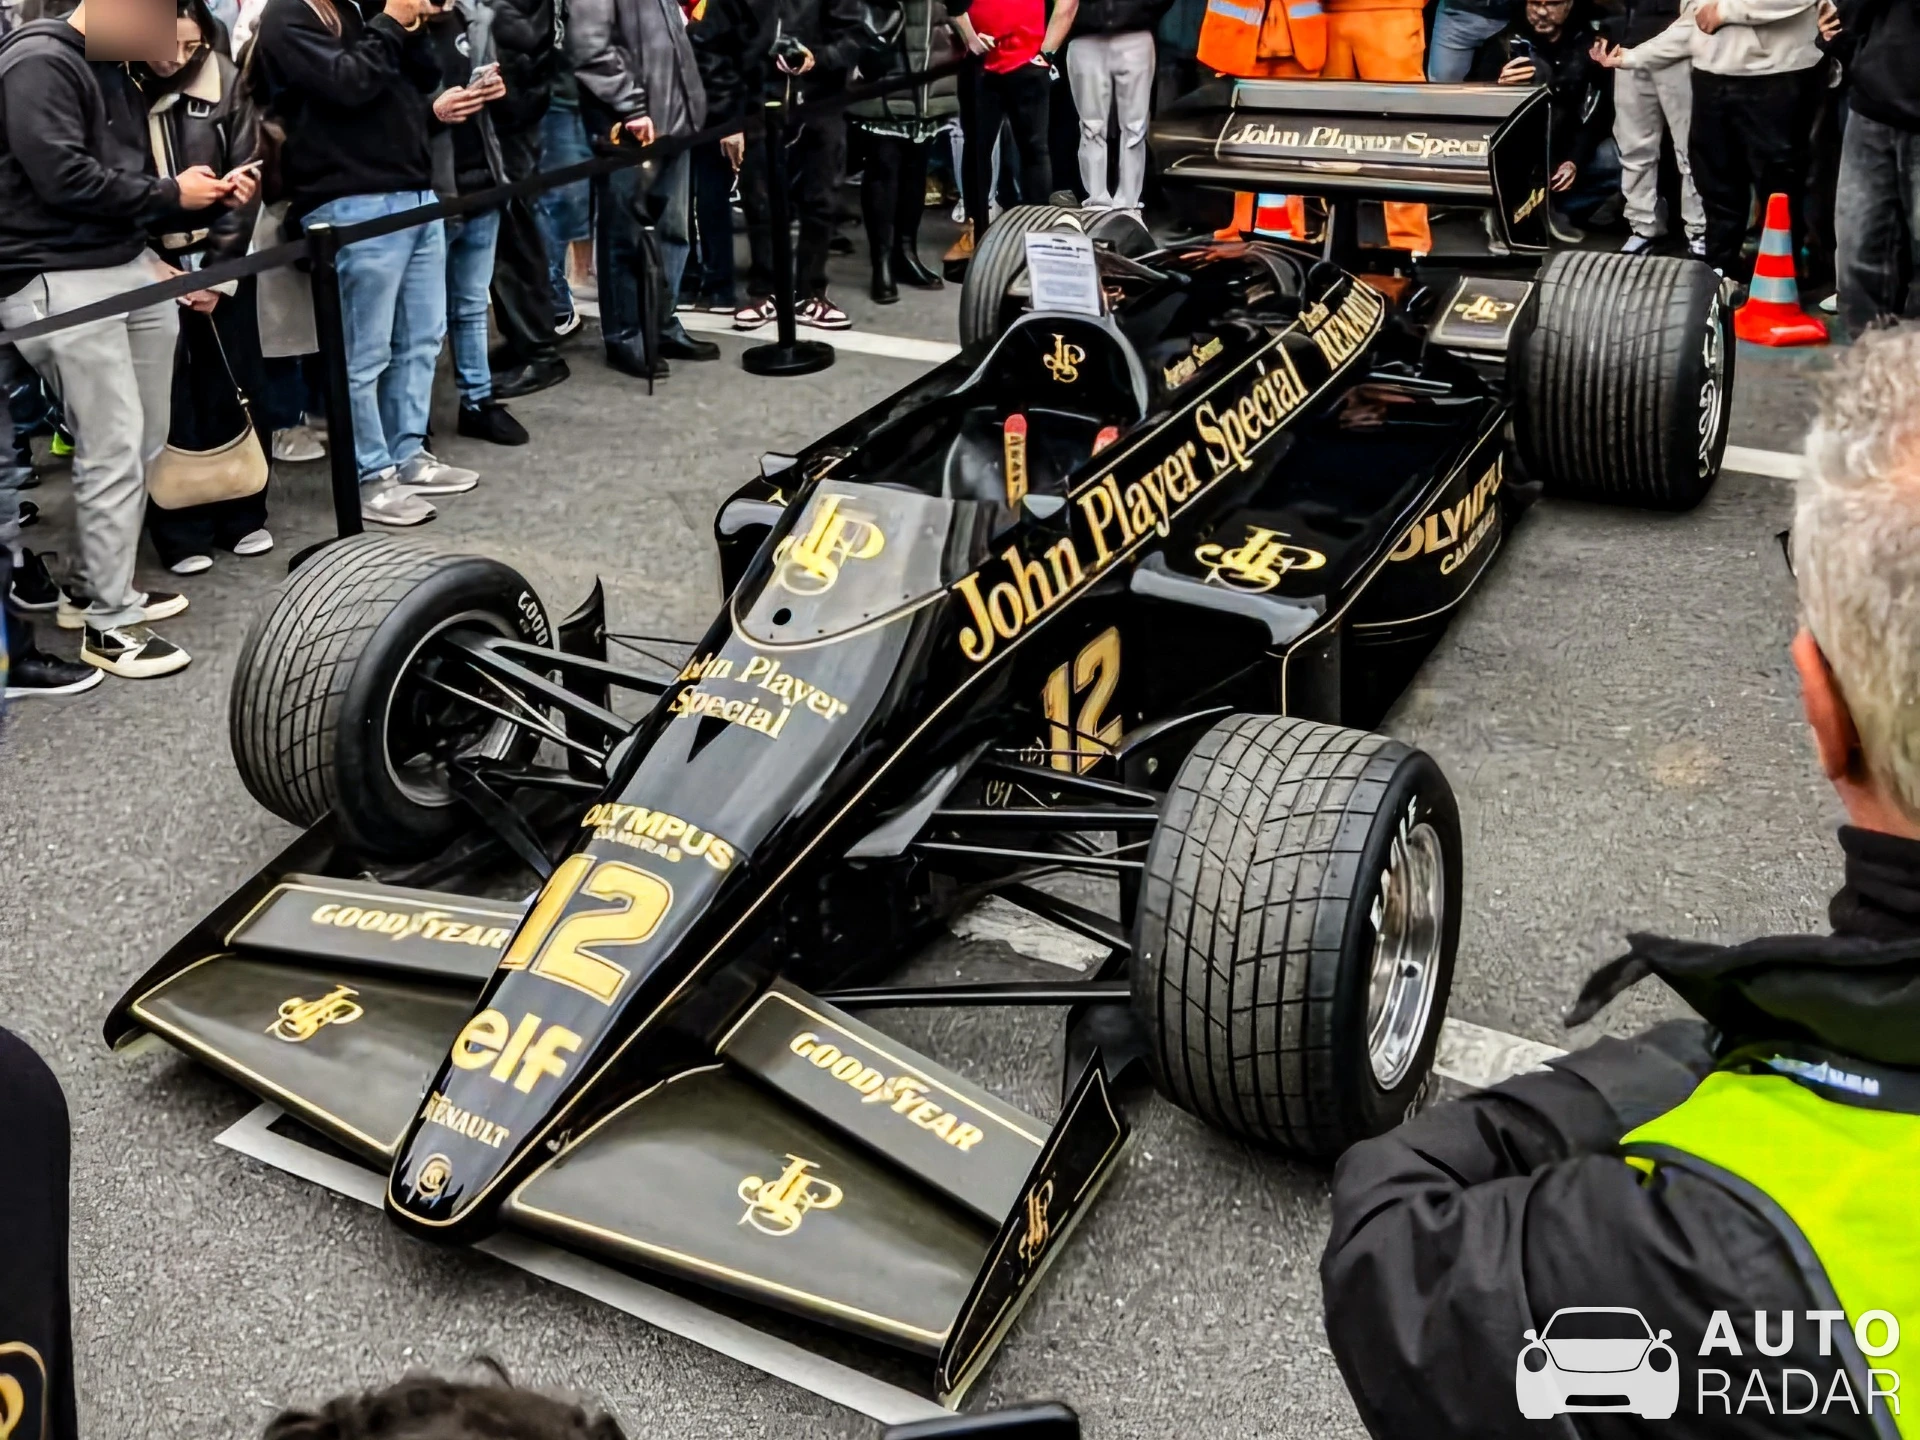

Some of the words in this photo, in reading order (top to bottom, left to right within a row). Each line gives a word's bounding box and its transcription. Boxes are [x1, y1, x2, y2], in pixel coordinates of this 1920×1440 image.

[1229, 124, 1299, 148] John
[1403, 132, 1491, 158] Speci
[952, 536, 1086, 663] John
[1076, 440, 1202, 569] Player
[1194, 341, 1310, 472] Special
[1389, 450, 1503, 561] OLYMPU
[667, 684, 792, 740] Special
[735, 656, 849, 722] Player
[1041, 626, 1123, 776] 12
[581, 803, 735, 871] OLYMPUS
[499, 853, 674, 1007] 12
[451, 1008, 582, 1094] elf
[789, 1032, 984, 1152] GOODYEAR
[420, 1090, 510, 1149] RENAULT
